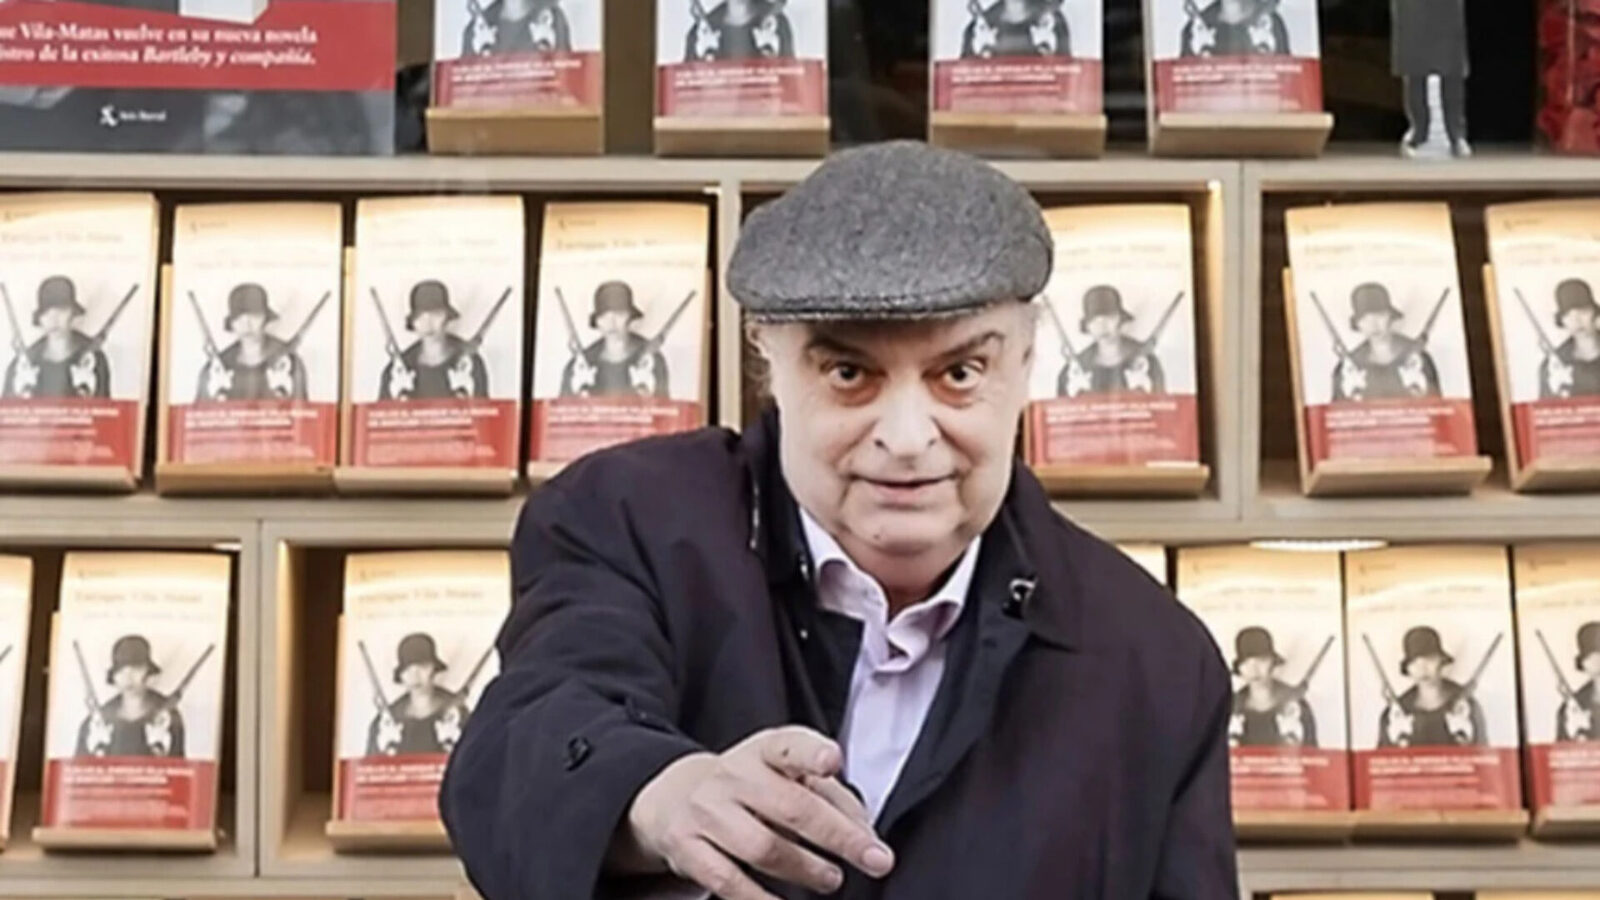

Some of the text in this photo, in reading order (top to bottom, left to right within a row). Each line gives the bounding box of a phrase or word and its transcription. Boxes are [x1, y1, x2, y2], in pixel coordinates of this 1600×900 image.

[20, 22, 110, 41] Vila-Matas
[113, 23, 164, 42] vuelve
[167, 29, 187, 43] en
[191, 29, 210, 43] su
[213, 29, 261, 43] nueva
[264, 25, 318, 44] novela
[38, 43, 58, 62] de
[62, 43, 78, 62] la
[81, 46, 140, 63] exitosa
[143, 46, 212, 68] Bartleby
[213, 50, 227, 69] y
